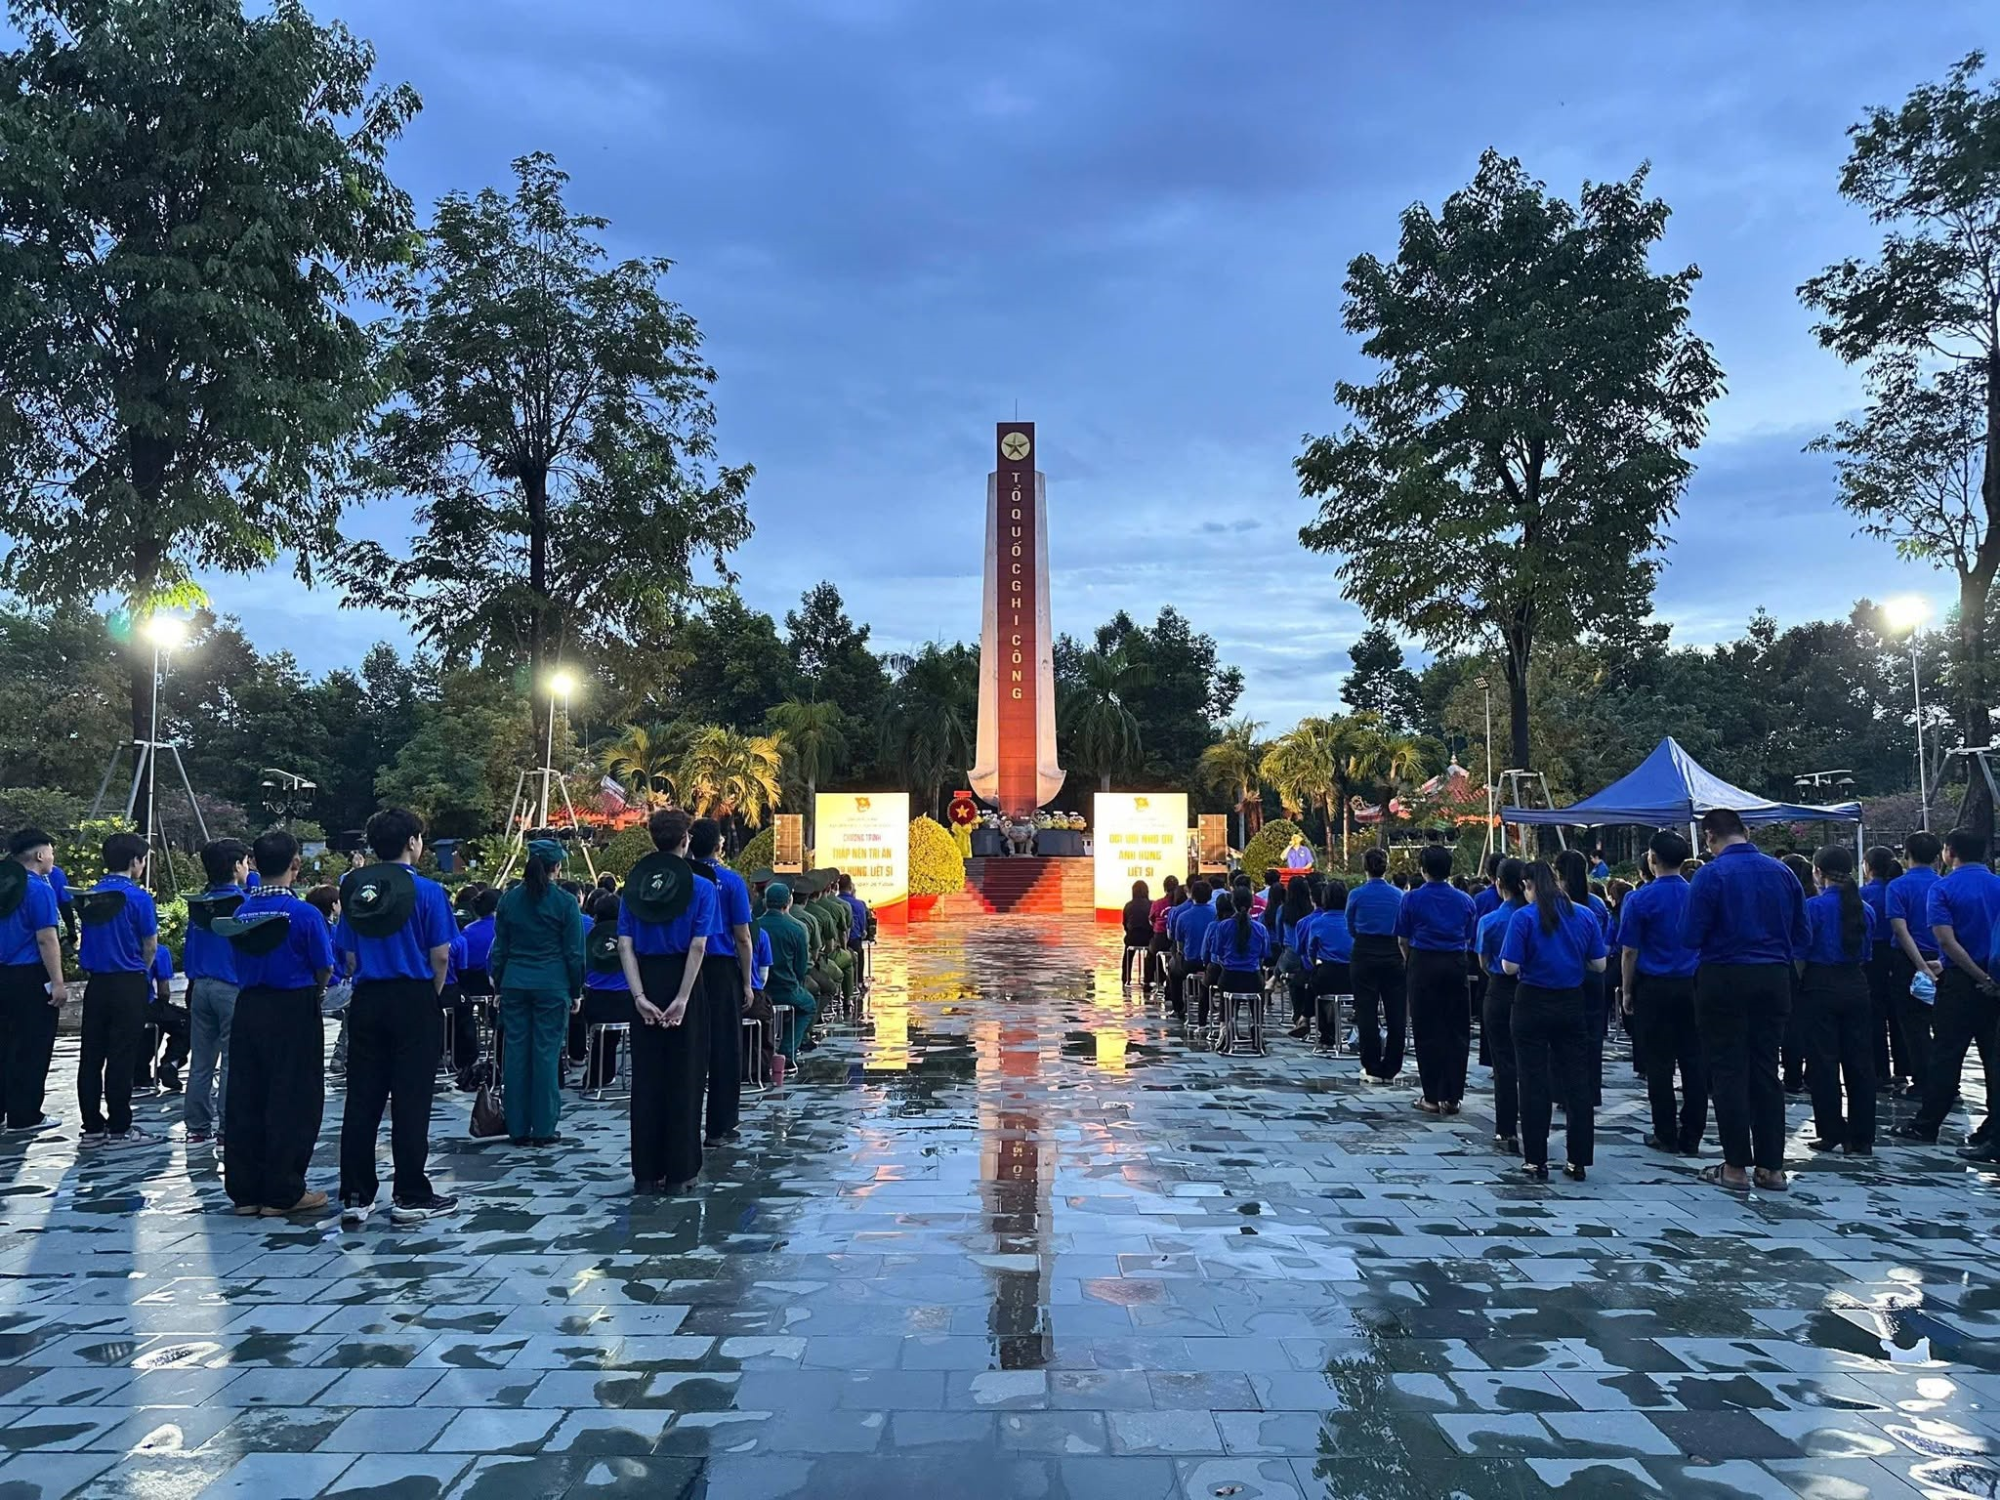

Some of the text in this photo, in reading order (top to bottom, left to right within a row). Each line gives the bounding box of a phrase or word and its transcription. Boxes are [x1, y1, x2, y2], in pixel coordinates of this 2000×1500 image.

[1011, 472, 1022, 699] TỔ QUỐC GHI CÔNG
